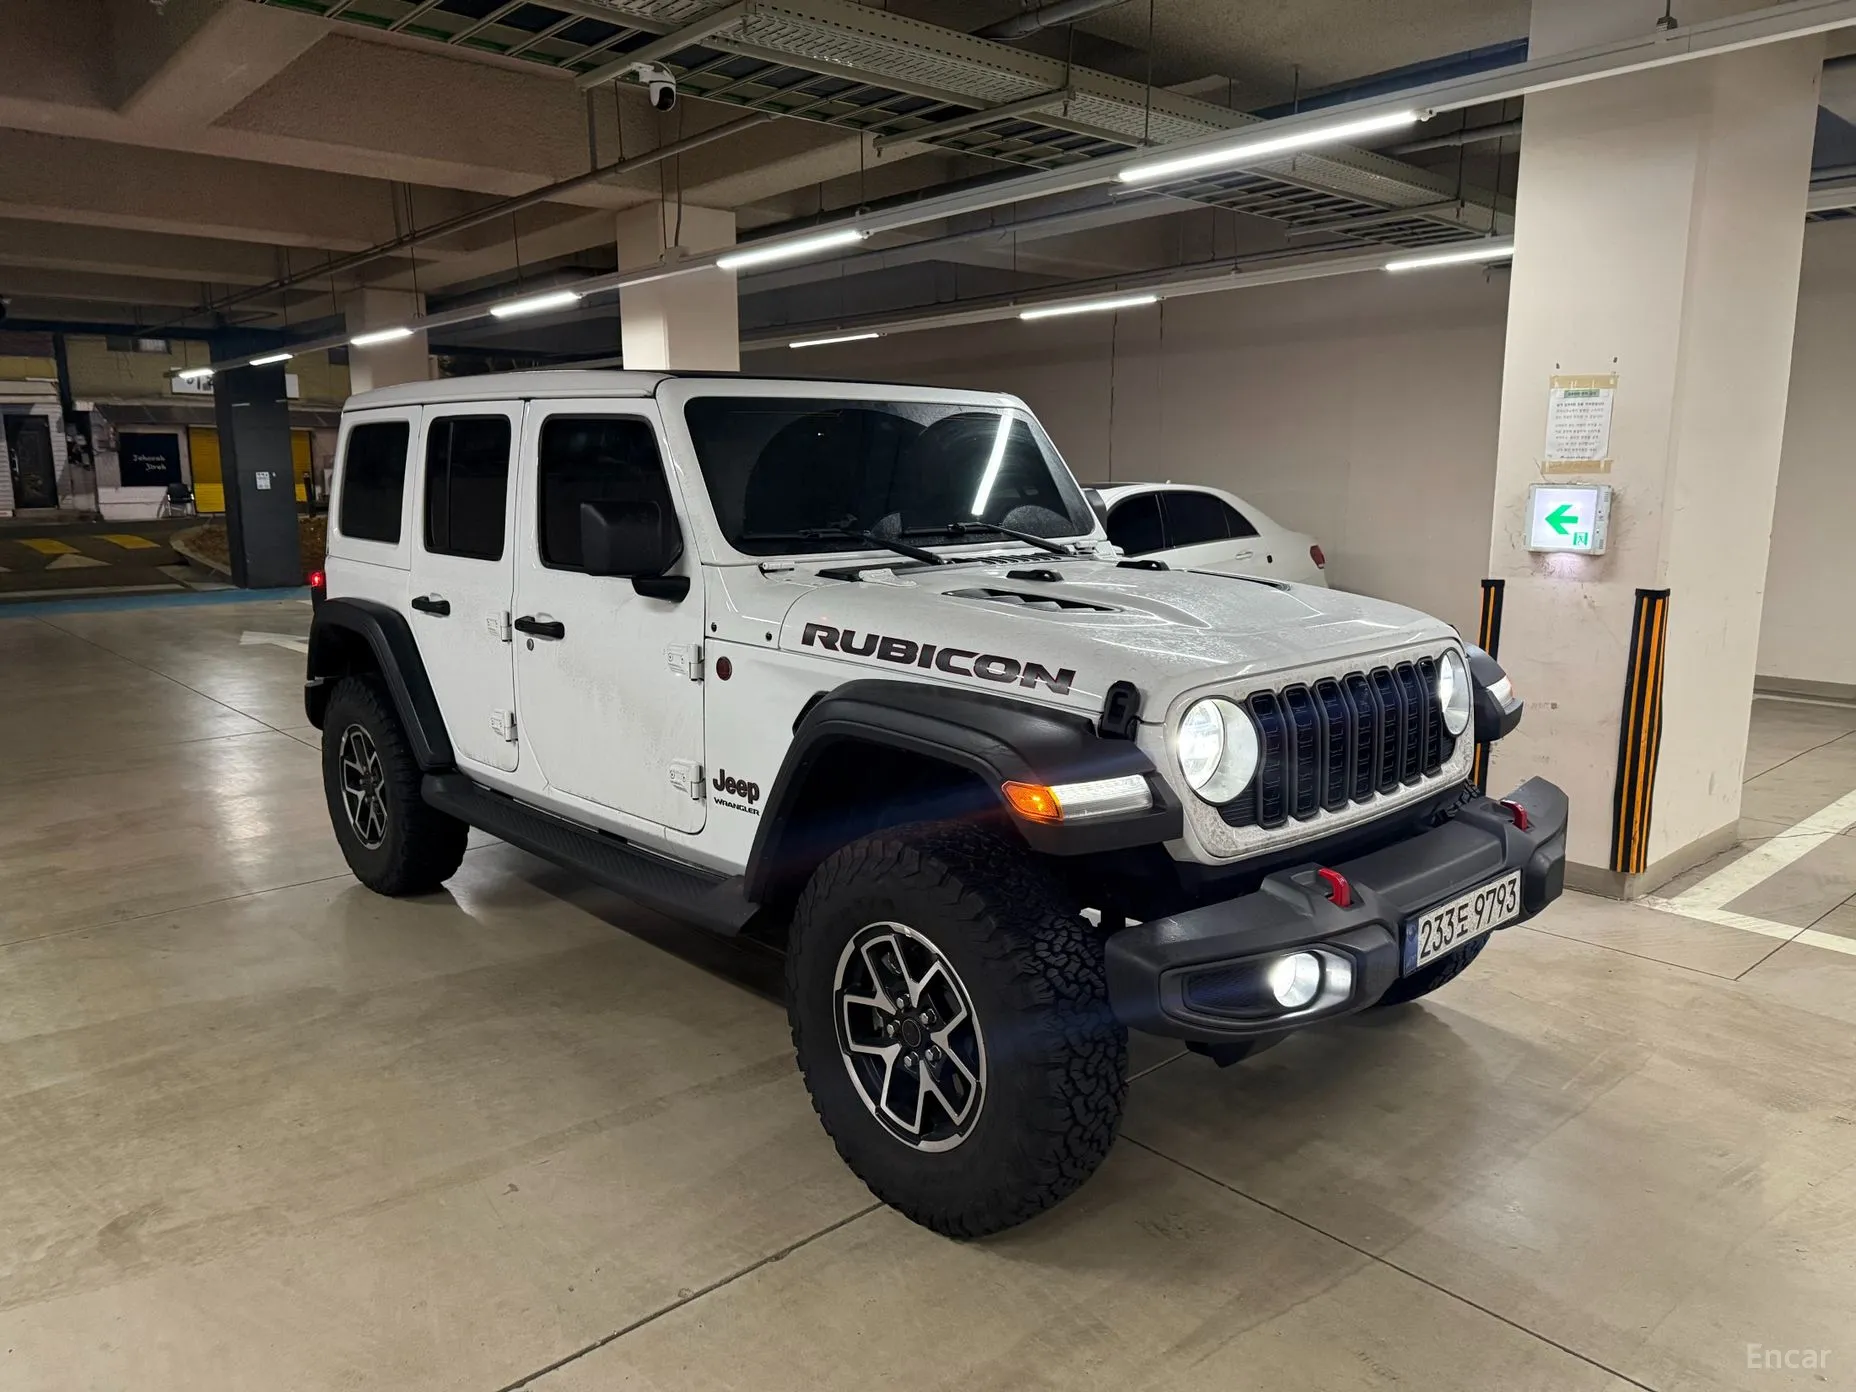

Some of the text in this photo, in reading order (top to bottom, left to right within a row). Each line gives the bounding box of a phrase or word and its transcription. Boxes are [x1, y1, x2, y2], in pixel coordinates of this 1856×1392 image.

[801, 622, 1077, 696] RUBICON
[713, 768, 760, 805] Jeep
[714, 797, 760, 816] WRANGLER
[1421, 878, 1517, 959] 233도 9793
